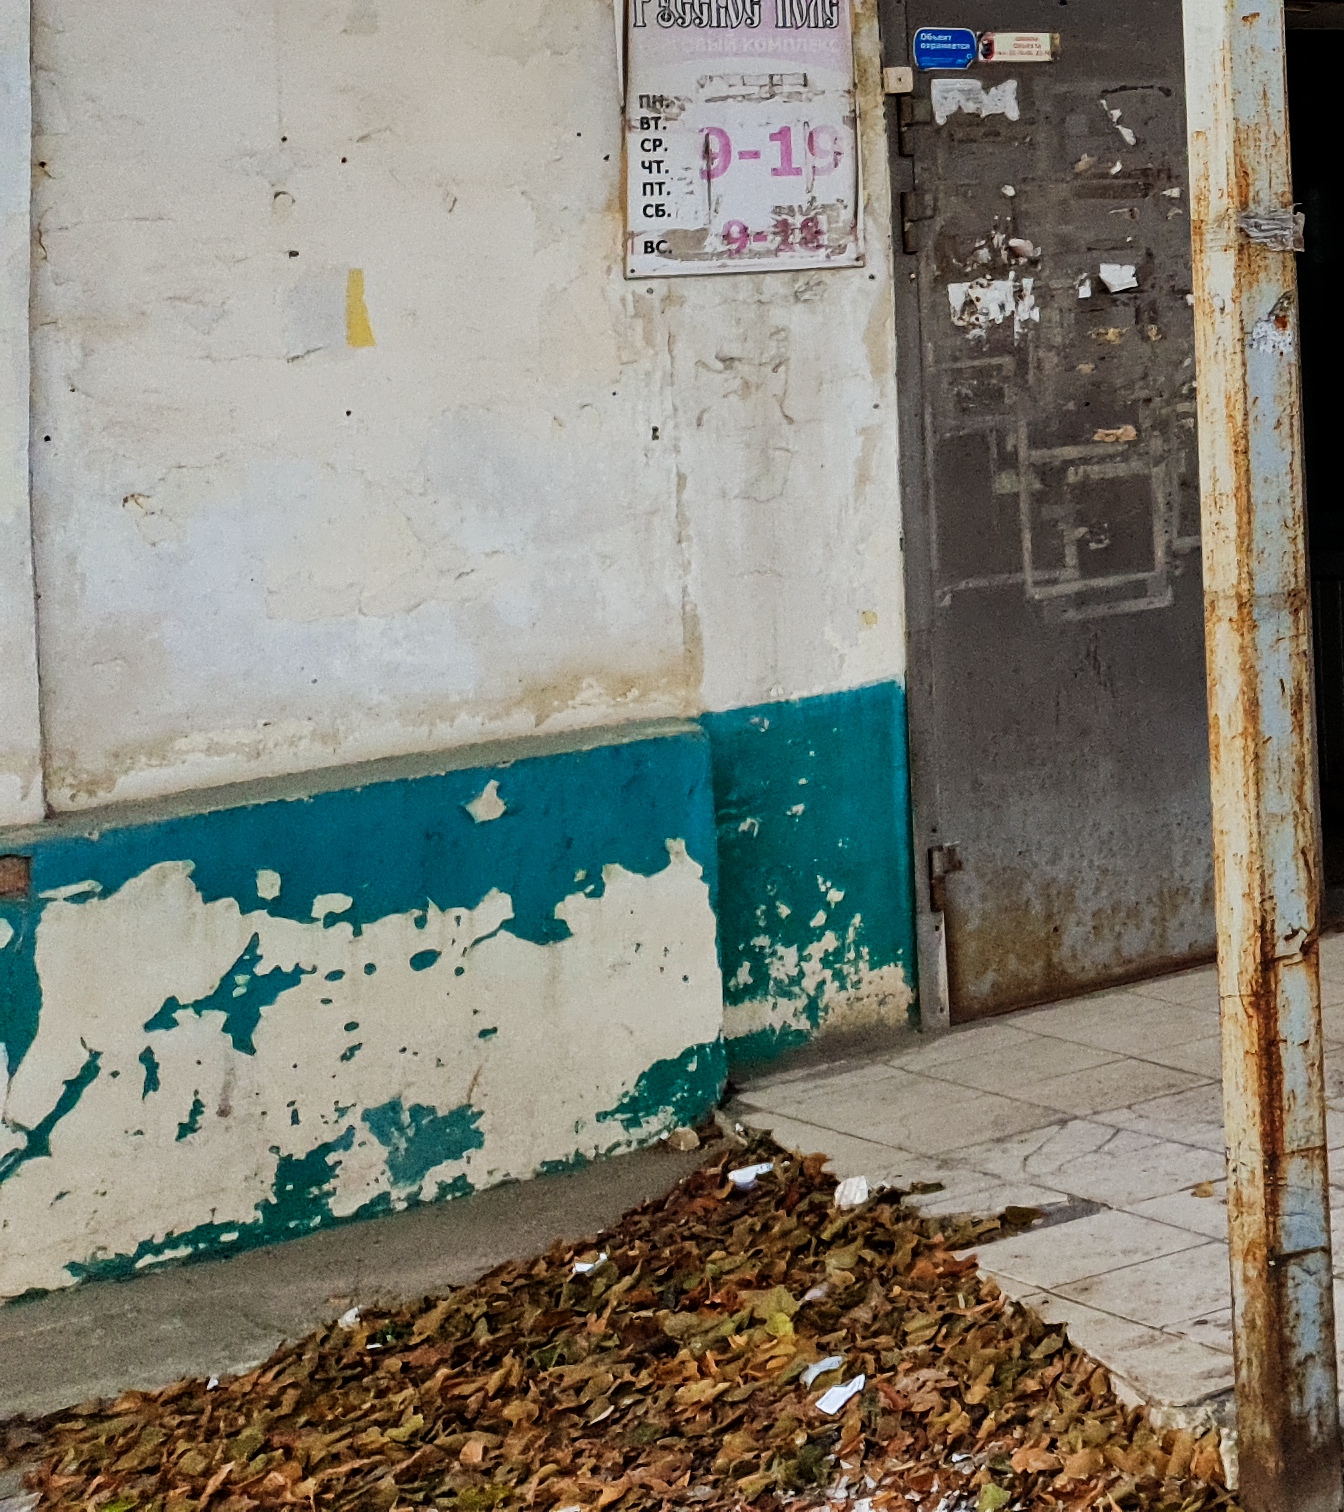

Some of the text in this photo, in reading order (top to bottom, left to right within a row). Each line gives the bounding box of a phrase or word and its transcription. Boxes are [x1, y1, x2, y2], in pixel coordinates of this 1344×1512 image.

[640, 116, 667, 131] ВТ.
[641, 138, 668, 153] СР.
[641, 160, 669, 175] ЧТ.
[642, 181, 671, 197] ПТ.
[642, 202, 672, 218] СБ.
[643, 239, 673, 255] ВС.
